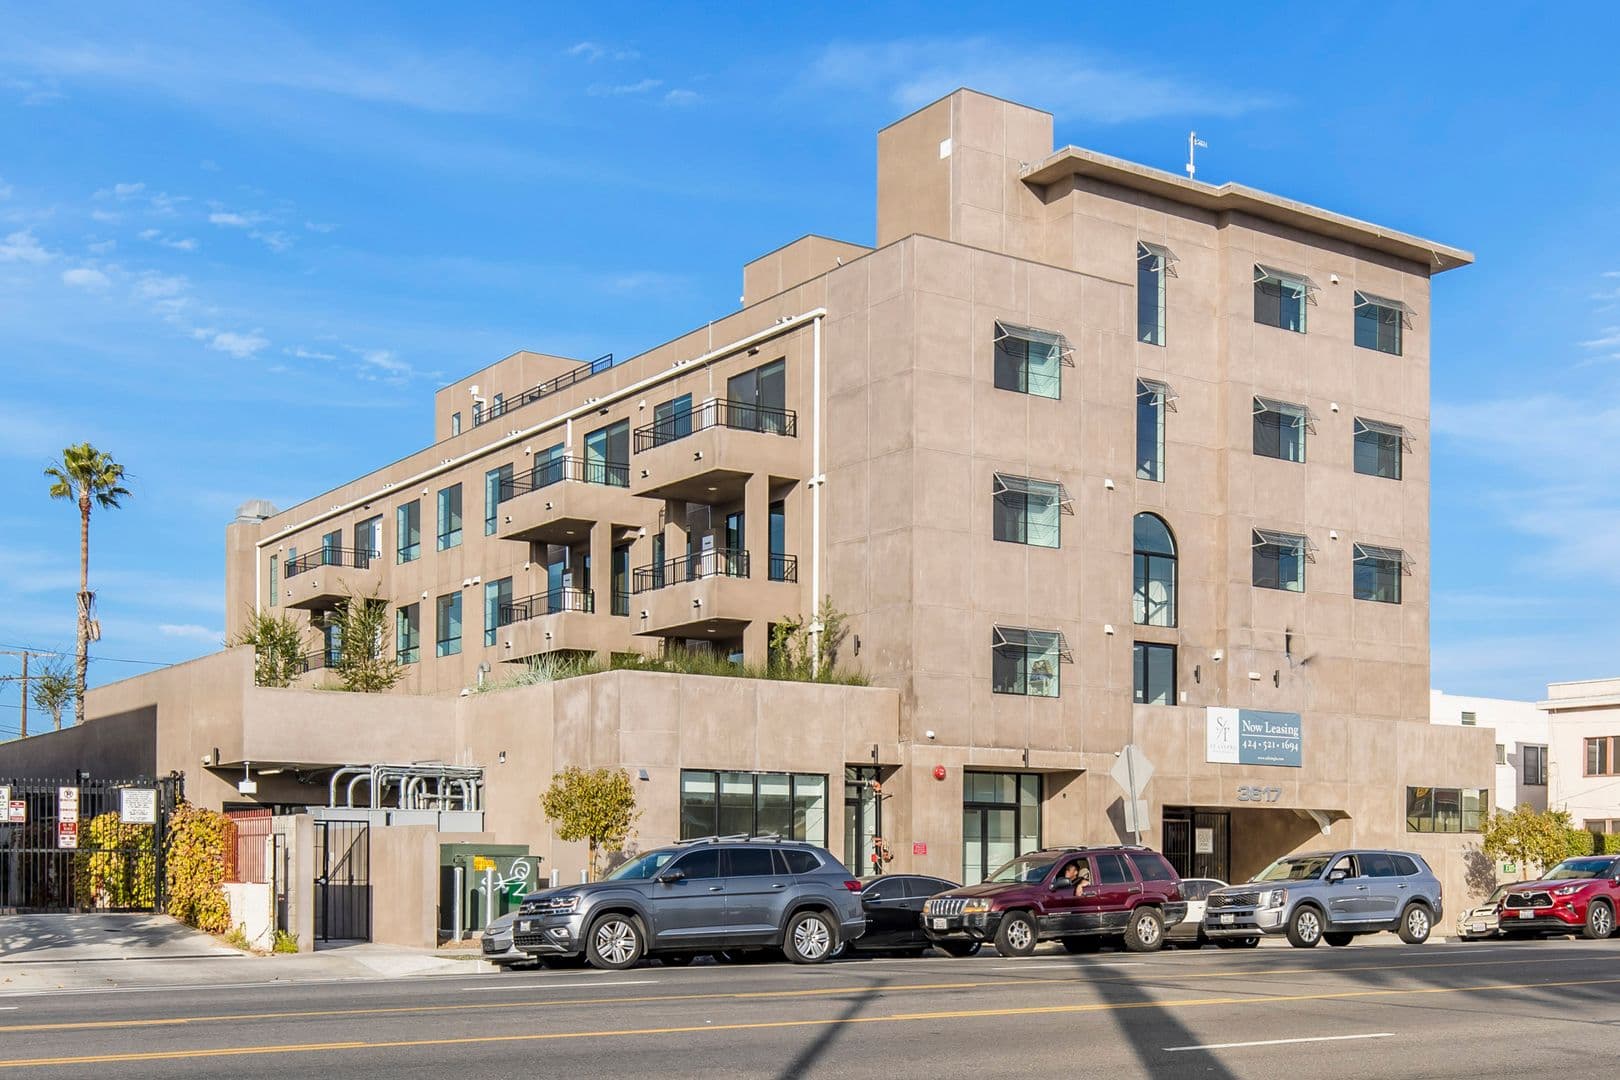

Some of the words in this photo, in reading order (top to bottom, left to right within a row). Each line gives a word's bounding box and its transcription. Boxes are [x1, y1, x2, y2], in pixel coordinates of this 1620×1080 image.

[1242, 720, 1262, 732] Now
[1265, 721, 1299, 737] Leasing
[1242, 740, 1256, 750] 424
[1263, 741, 1275, 751] 521
[1281, 740, 1298, 752] 1694
